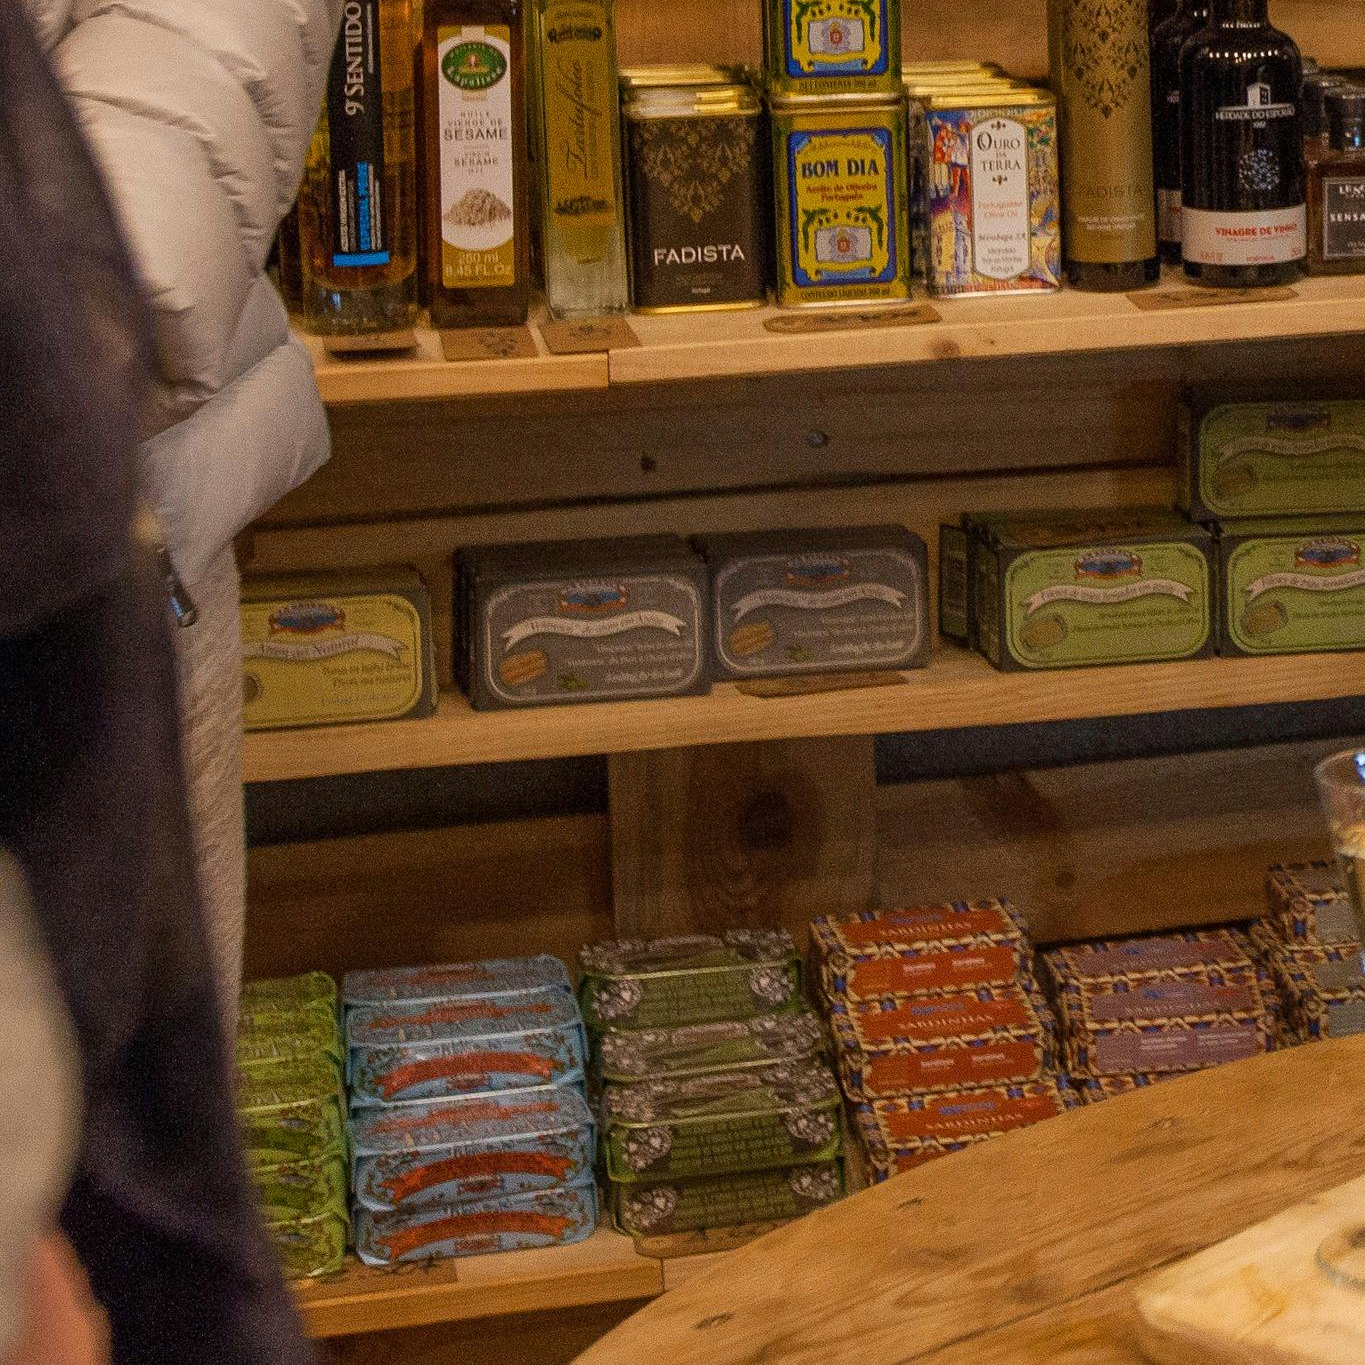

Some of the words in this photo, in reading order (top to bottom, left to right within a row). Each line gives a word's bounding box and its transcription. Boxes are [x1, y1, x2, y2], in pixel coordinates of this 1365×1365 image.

[976, 131, 1021, 152] OURO
[802, 159, 839, 179] BOM
[847, 158, 880, 177] DIA
[979, 158, 1021, 172] TERRA
[653, 244, 746, 266] FADISTA
